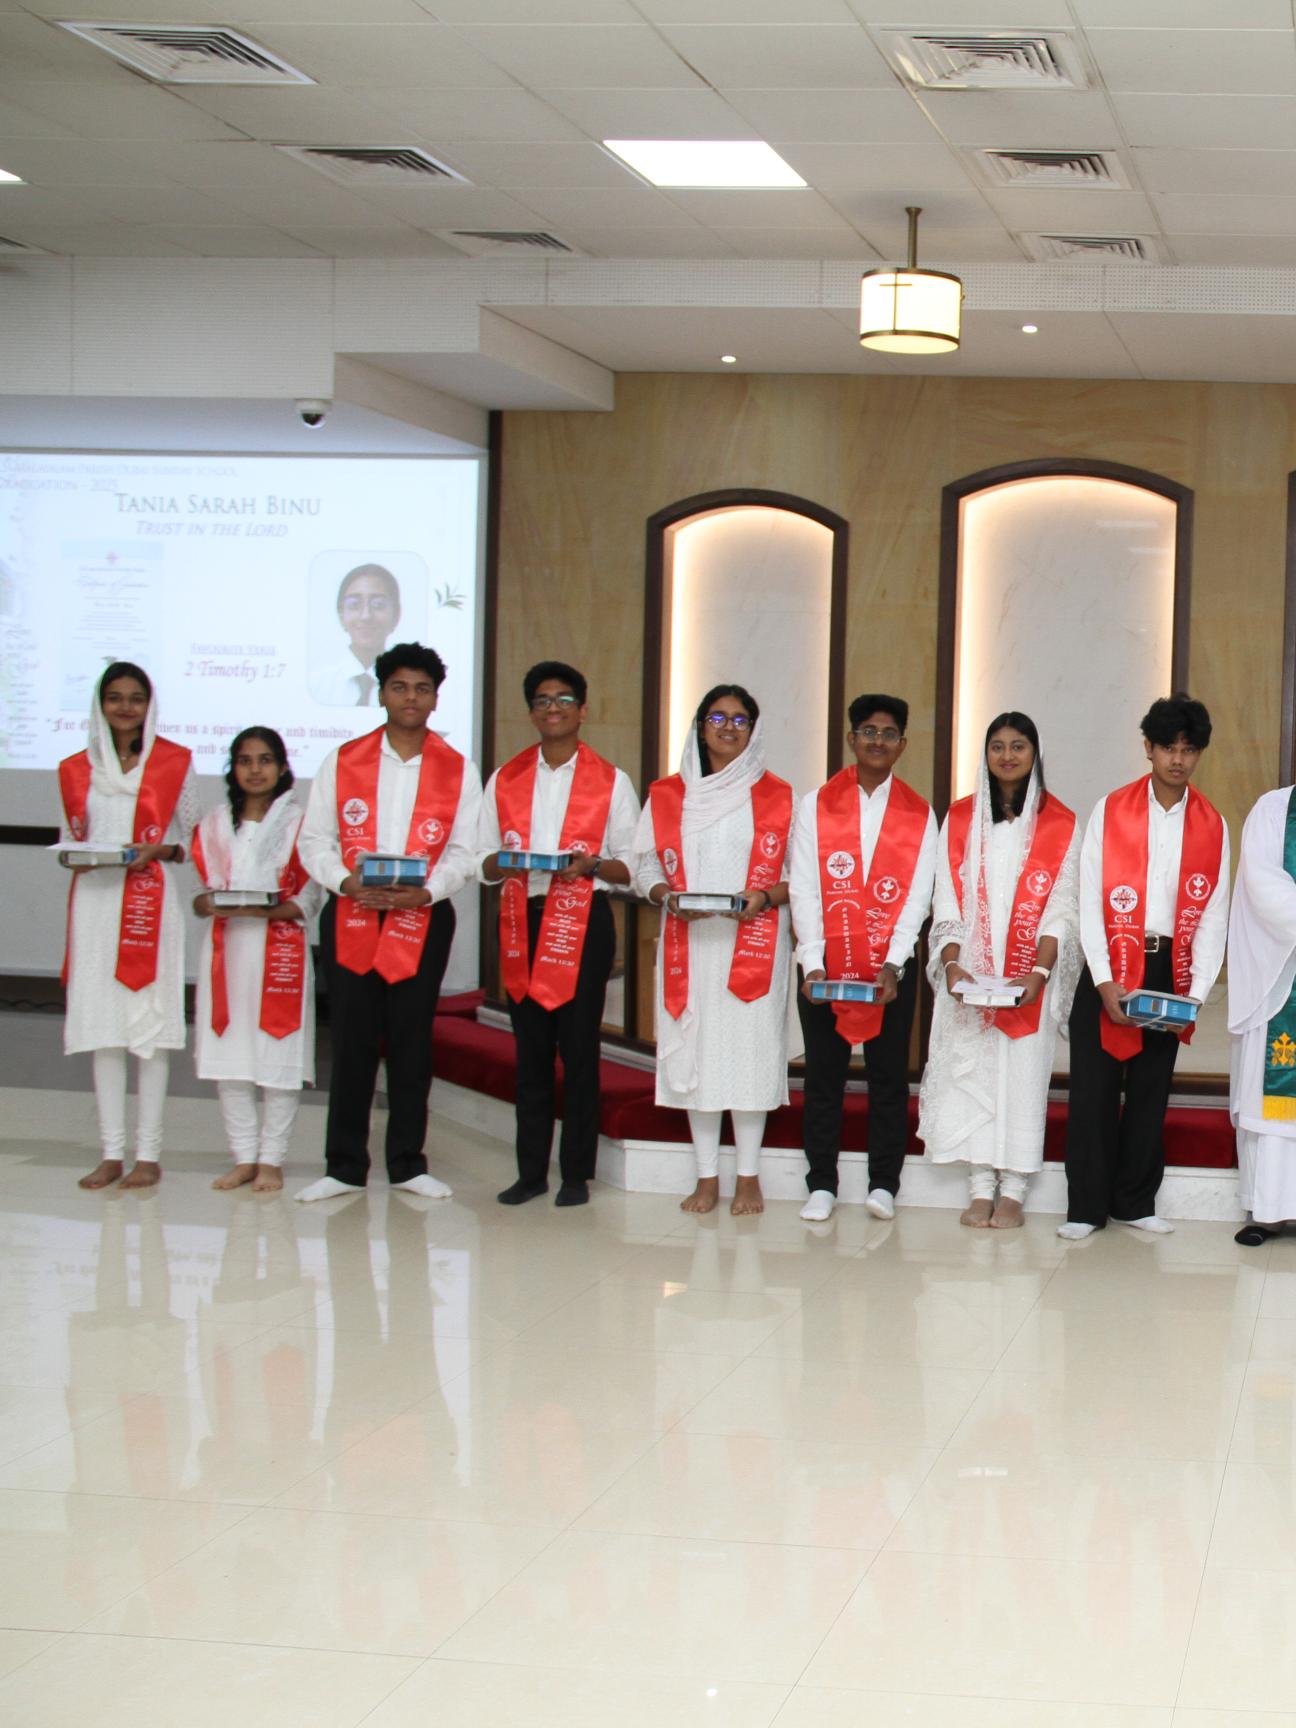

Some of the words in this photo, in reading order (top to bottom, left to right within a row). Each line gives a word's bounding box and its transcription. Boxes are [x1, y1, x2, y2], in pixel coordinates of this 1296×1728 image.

[114, 492, 179, 513] TANIA
[187, 493, 256, 515] SARAH
[265, 495, 321, 516] BINU
[135, 520, 185, 535] TRUST
[187, 523, 207, 535] IN
[211, 523, 244, 536] THE
[244, 522, 289, 538] LORD
[185, 661, 193, 677] 2
[197, 660, 258, 682] Timothy
[263, 662, 287, 678] 1:7
[346, 828, 364, 836] CSI
[833, 880, 851, 889] CSI
[1114, 914, 1132, 923] CSI
[840, 972, 860, 980] 2024
